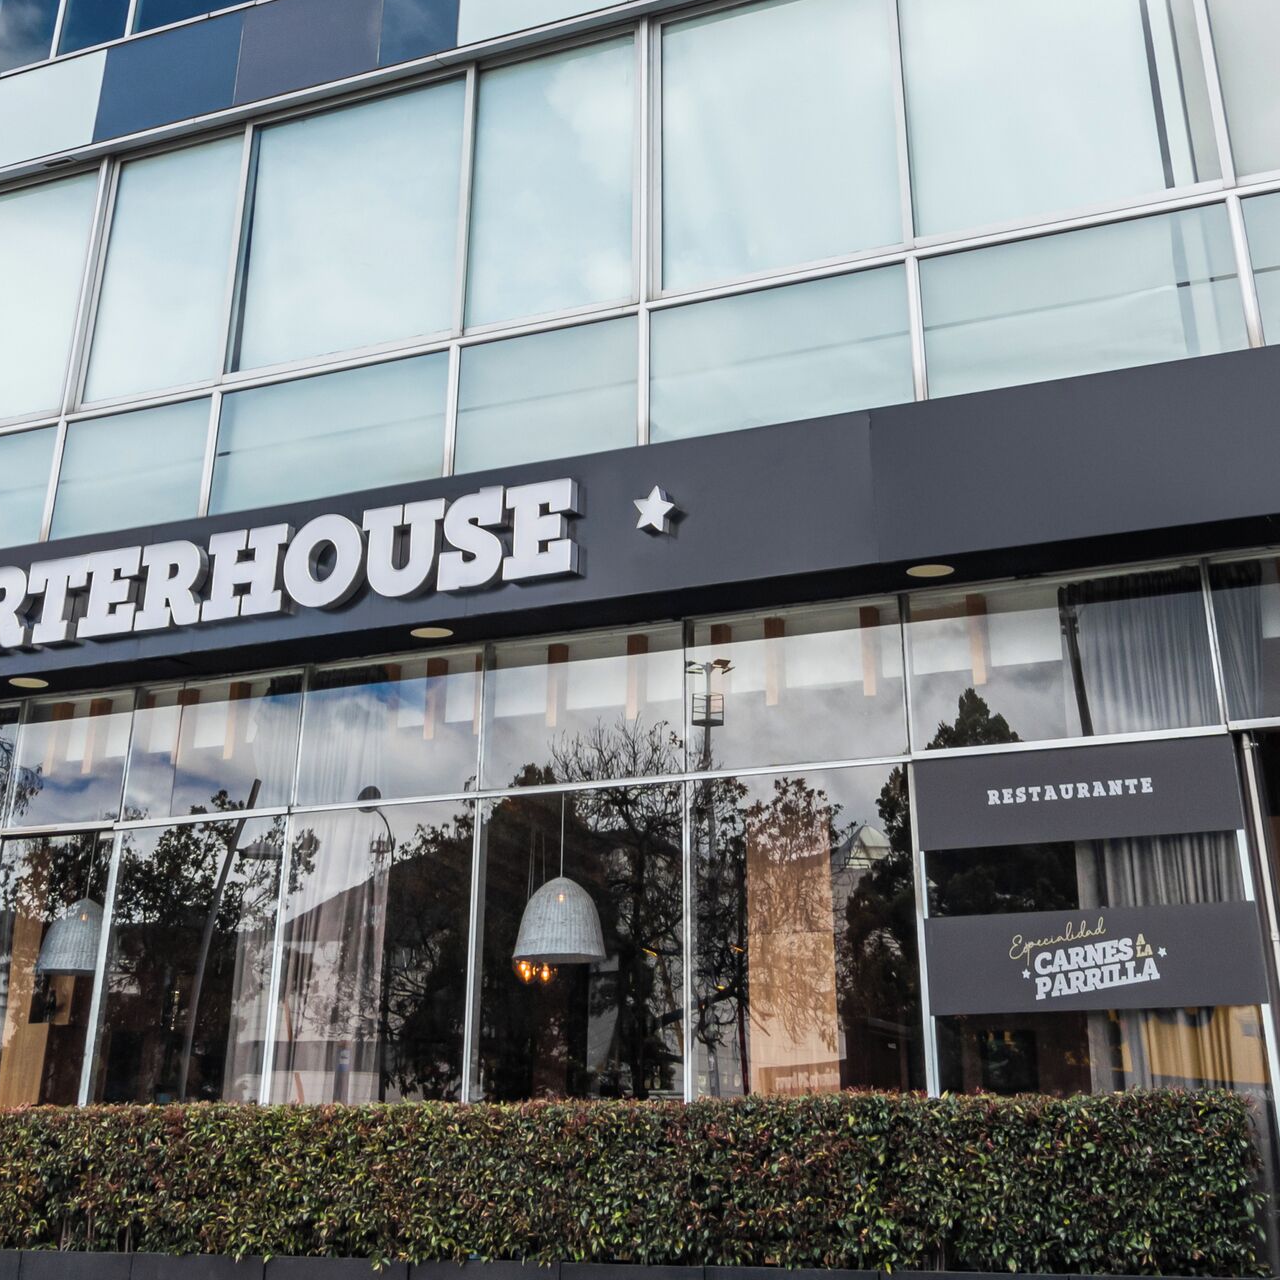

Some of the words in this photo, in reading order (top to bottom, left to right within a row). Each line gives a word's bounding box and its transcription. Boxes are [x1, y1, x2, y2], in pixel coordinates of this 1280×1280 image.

[987, 777, 1153, 805] RESTAURANTE
[1009, 916, 1106, 966] Especialidad
[1034, 937, 1134, 975] CARNES
[1135, 933, 1146, 946] A
[1135, 944, 1154, 957] LA
[1035, 957, 1161, 1001] PARRILLA
